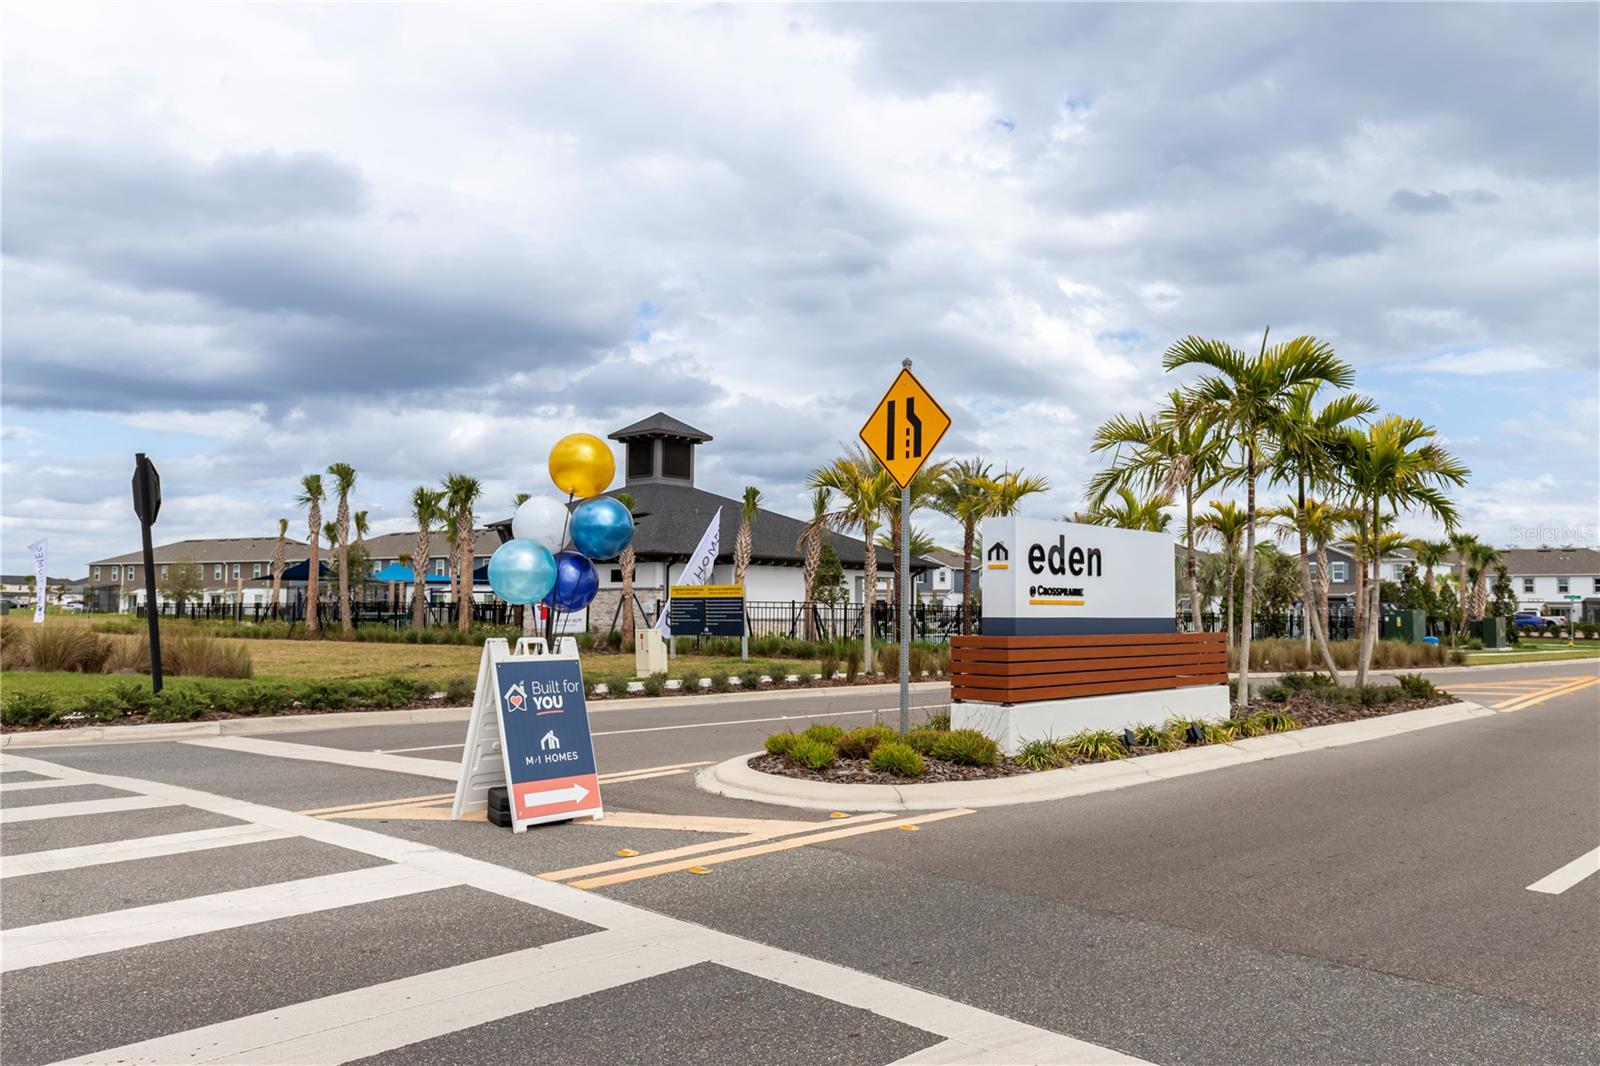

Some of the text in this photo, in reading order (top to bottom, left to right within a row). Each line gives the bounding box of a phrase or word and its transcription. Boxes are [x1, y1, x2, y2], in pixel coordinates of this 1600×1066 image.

[1028, 534, 1102, 577] eden
[1029, 585, 1037, 598] @
[531, 679, 580, 695] Built for
[533, 695, 564, 710] YOU
[544, 751, 579, 764] HOMES
